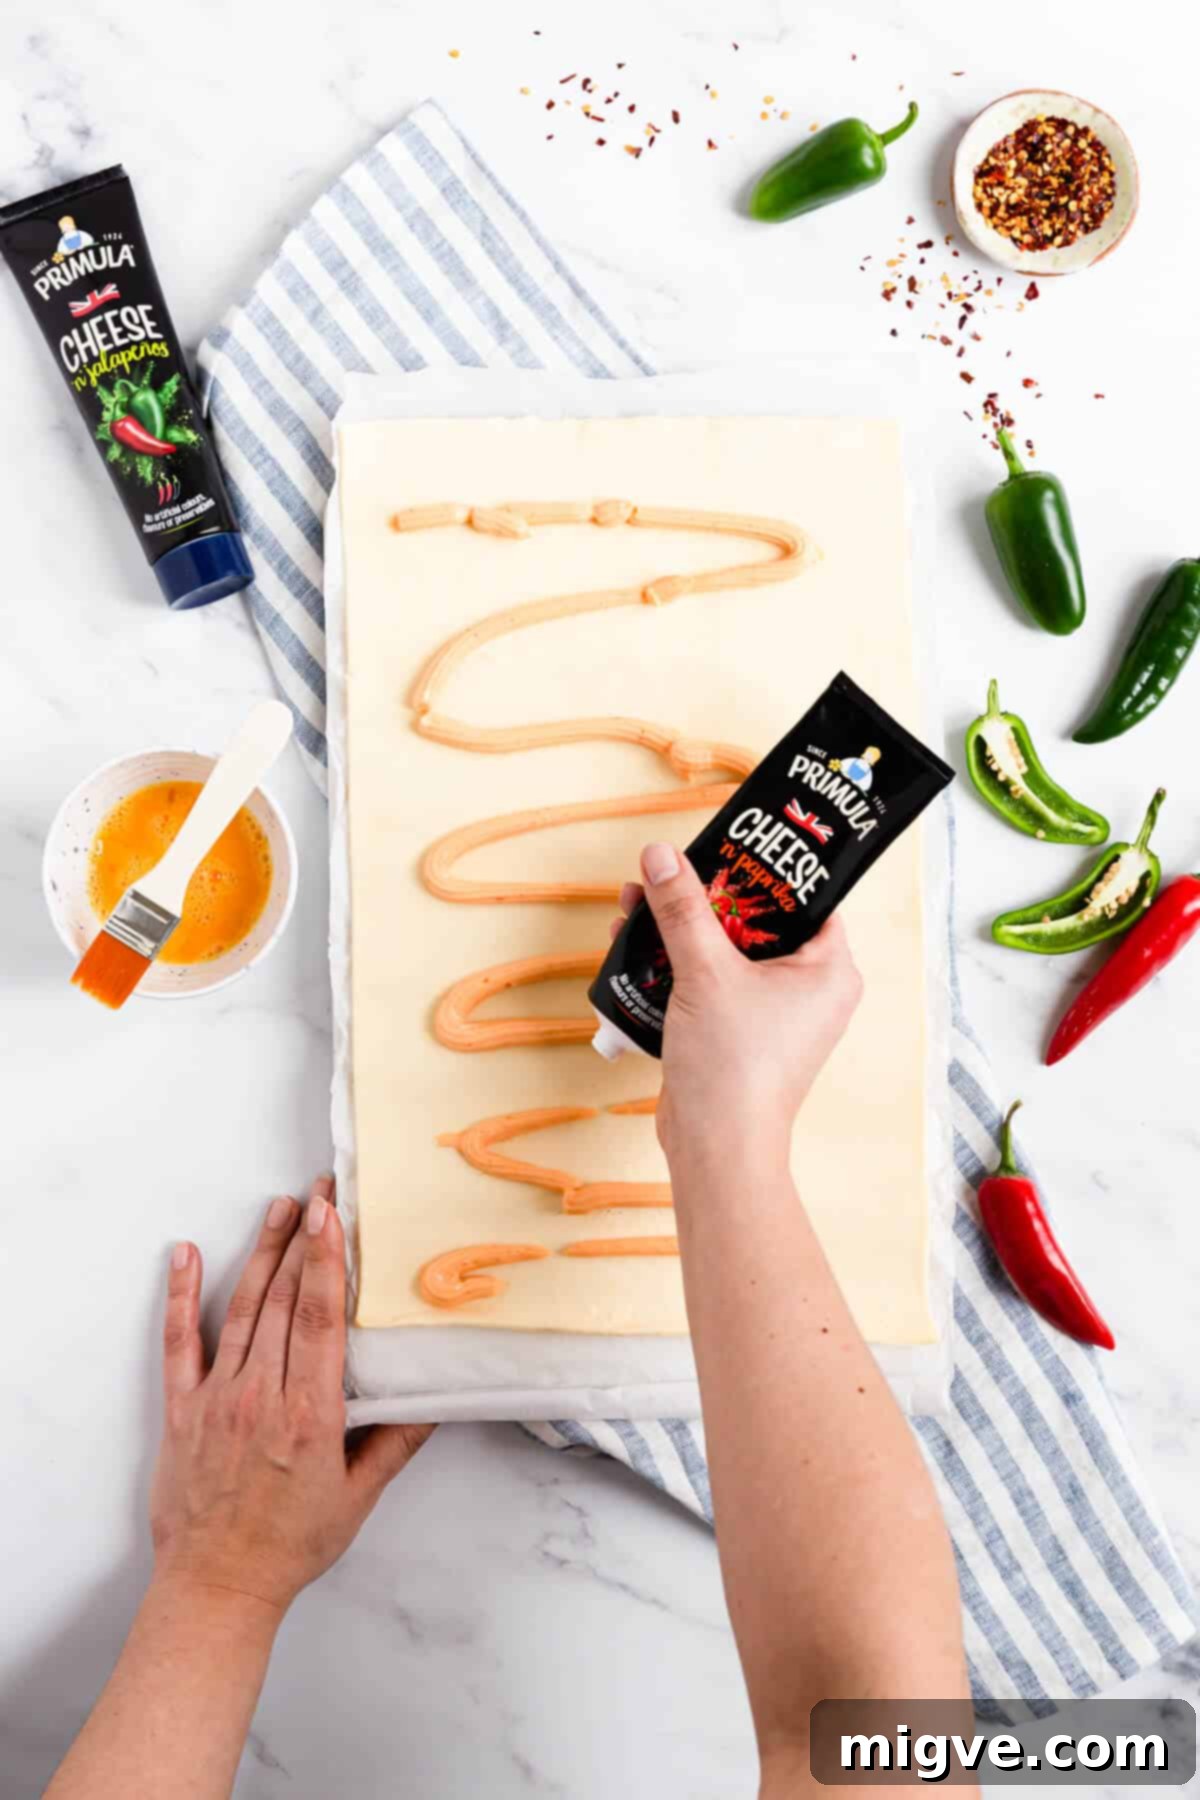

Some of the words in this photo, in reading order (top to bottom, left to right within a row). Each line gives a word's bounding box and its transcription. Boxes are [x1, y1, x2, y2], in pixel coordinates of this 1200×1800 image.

[30, 260, 48, 275] SINCE
[33, 244, 136, 301] PRIMULA
[59, 304, 164, 373] CHEESE
[806, 744, 828, 759] SINCE
[787, 754, 878, 841] PRIMULA
[728, 807, 830, 906] CHEESE
[731, 852, 797, 912] paprika
